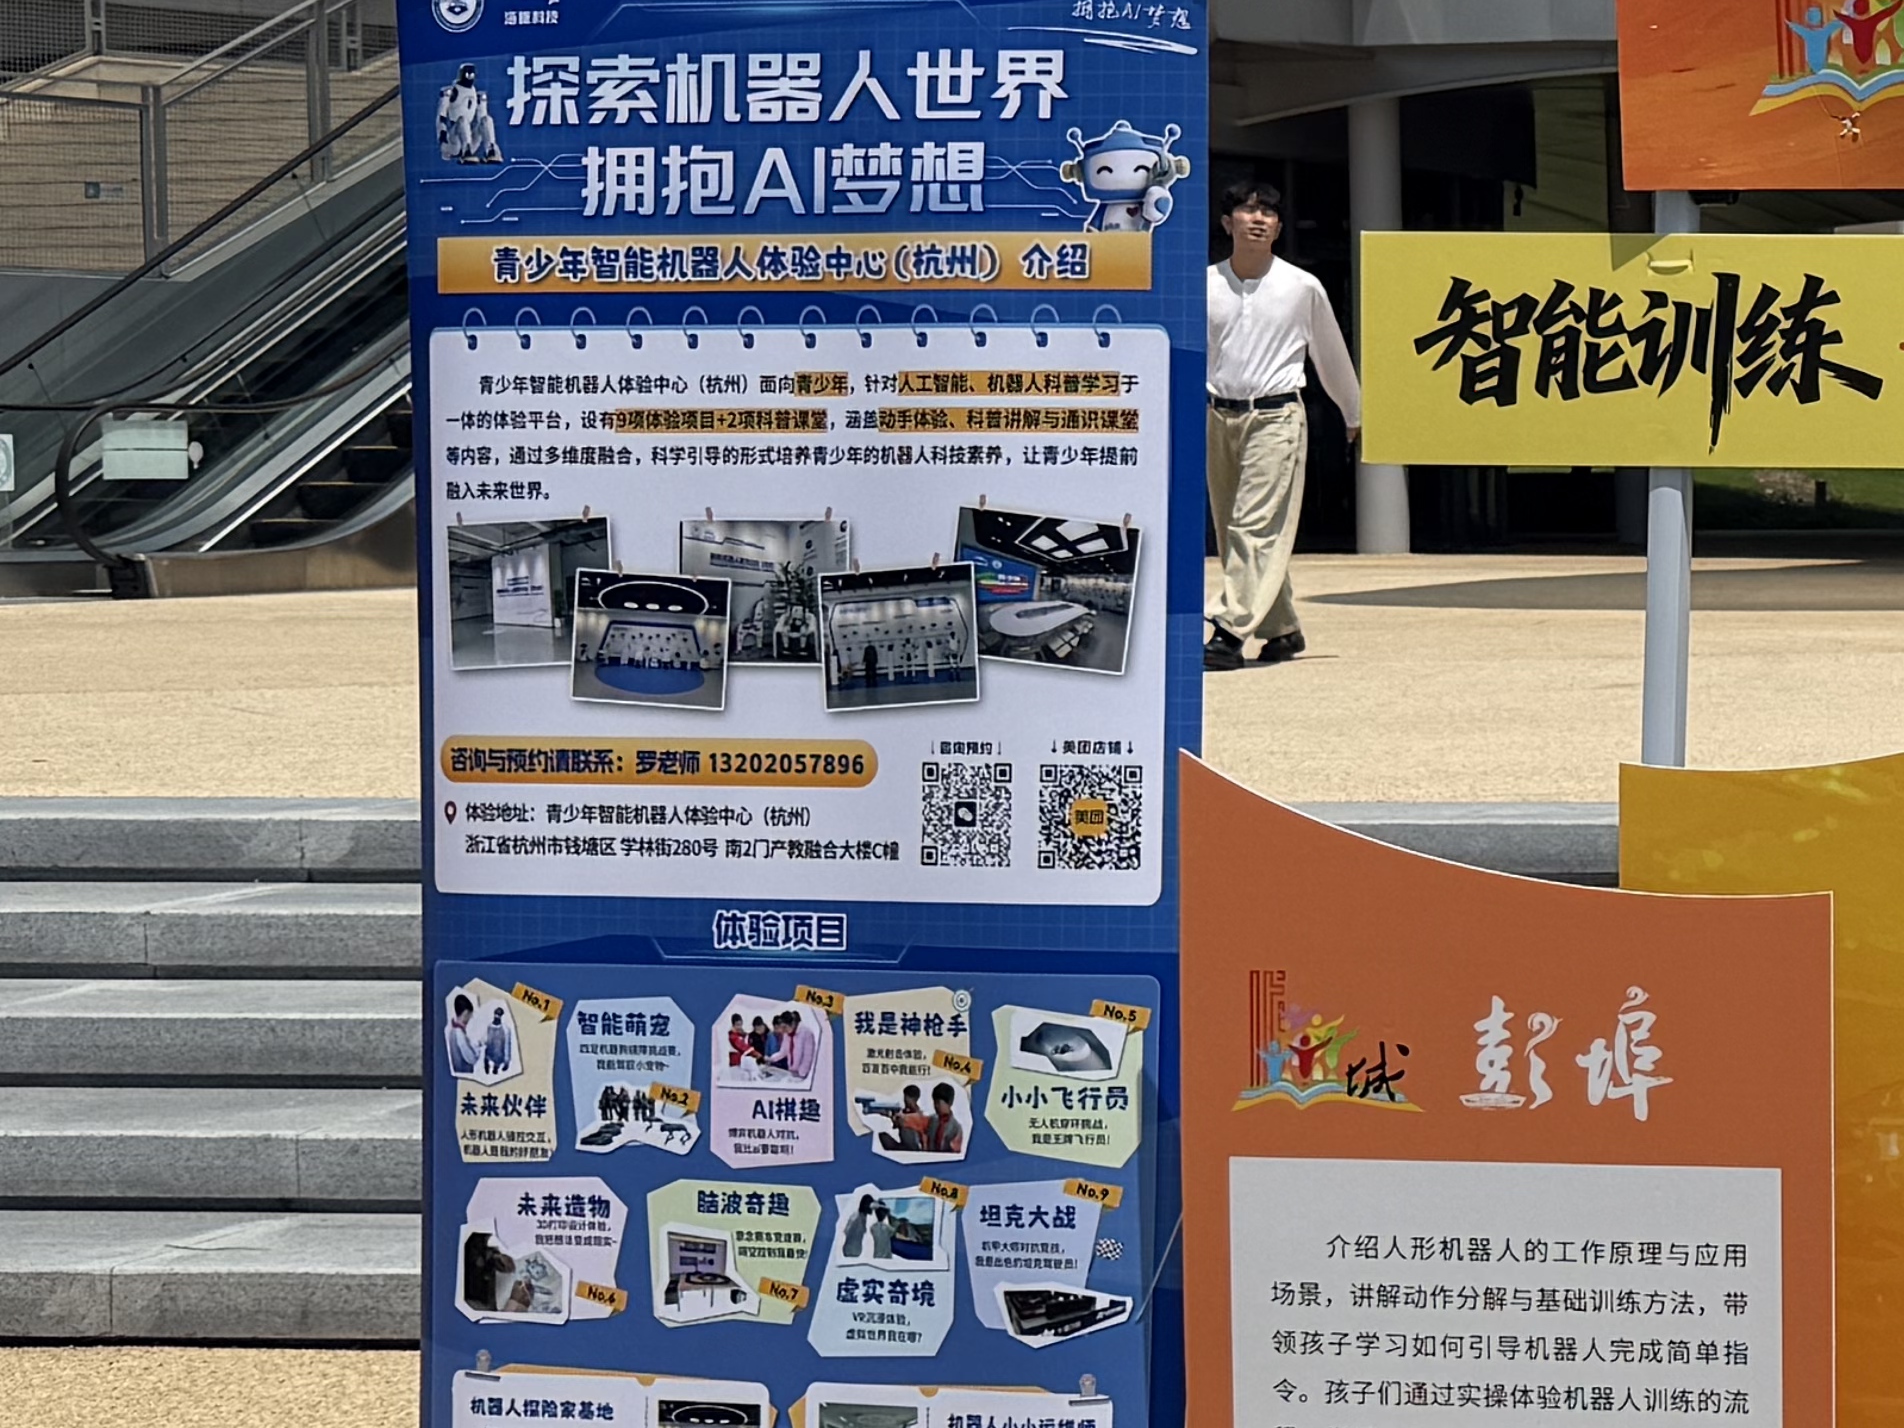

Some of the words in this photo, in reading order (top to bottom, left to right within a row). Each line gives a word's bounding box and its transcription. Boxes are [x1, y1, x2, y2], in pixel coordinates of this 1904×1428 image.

[506, 48, 1069, 129] 探索机器人世界
[581, 141, 988, 217] 拥抱AI梦想
[1413, 271, 1884, 455] 智能训练
[446, 481, 551, 501] 融入未来世界。
[708, 751, 865, 775] 13202057896
[712, 911, 848, 951] 体验项目
[522, 988, 551, 1011] No.1
[804, 989, 834, 1008] No.3
[577, 1011, 671, 1038] 智能萌宠
[854, 1011, 968, 1038] 我是神枪手
[1103, 1004, 1137, 1022] No.5
[942, 1056, 972, 1075] No.4
[1460, 985, 1674, 1122] 彭埠
[460, 1092, 547, 1119] 未来伙伴
[659, 1087, 689, 1104] No.2
[1001, 1084, 1129, 1112] 小小飞行员
[752, 1098, 821, 1123] AI棋趣
[930, 1181, 959, 1200] No.8
[1076, 1183, 1110, 1201] No.9
[517, 1191, 611, 1220] 未来造物
[980, 1204, 1077, 1230] 坦克大战
[1325, 1234, 1748, 1269] 介绍人形机器人的工作原理与应用
[586, 1285, 617, 1304] No.6
[769, 1283, 799, 1302] No.7
[836, 1277, 936, 1307] 虚实奇境
[1271, 1281, 1749, 1318] 场景，讲解动作分解与基础训练方法，带
[1271, 1331, 1749, 1366] 领孩子学习如何引导机器人完成简单指
[470, 1396, 615, 1421] 机器人探险家基地
[1273, 1379, 1750, 1415] 令。孩子们通过实操体验机器人训练的流
